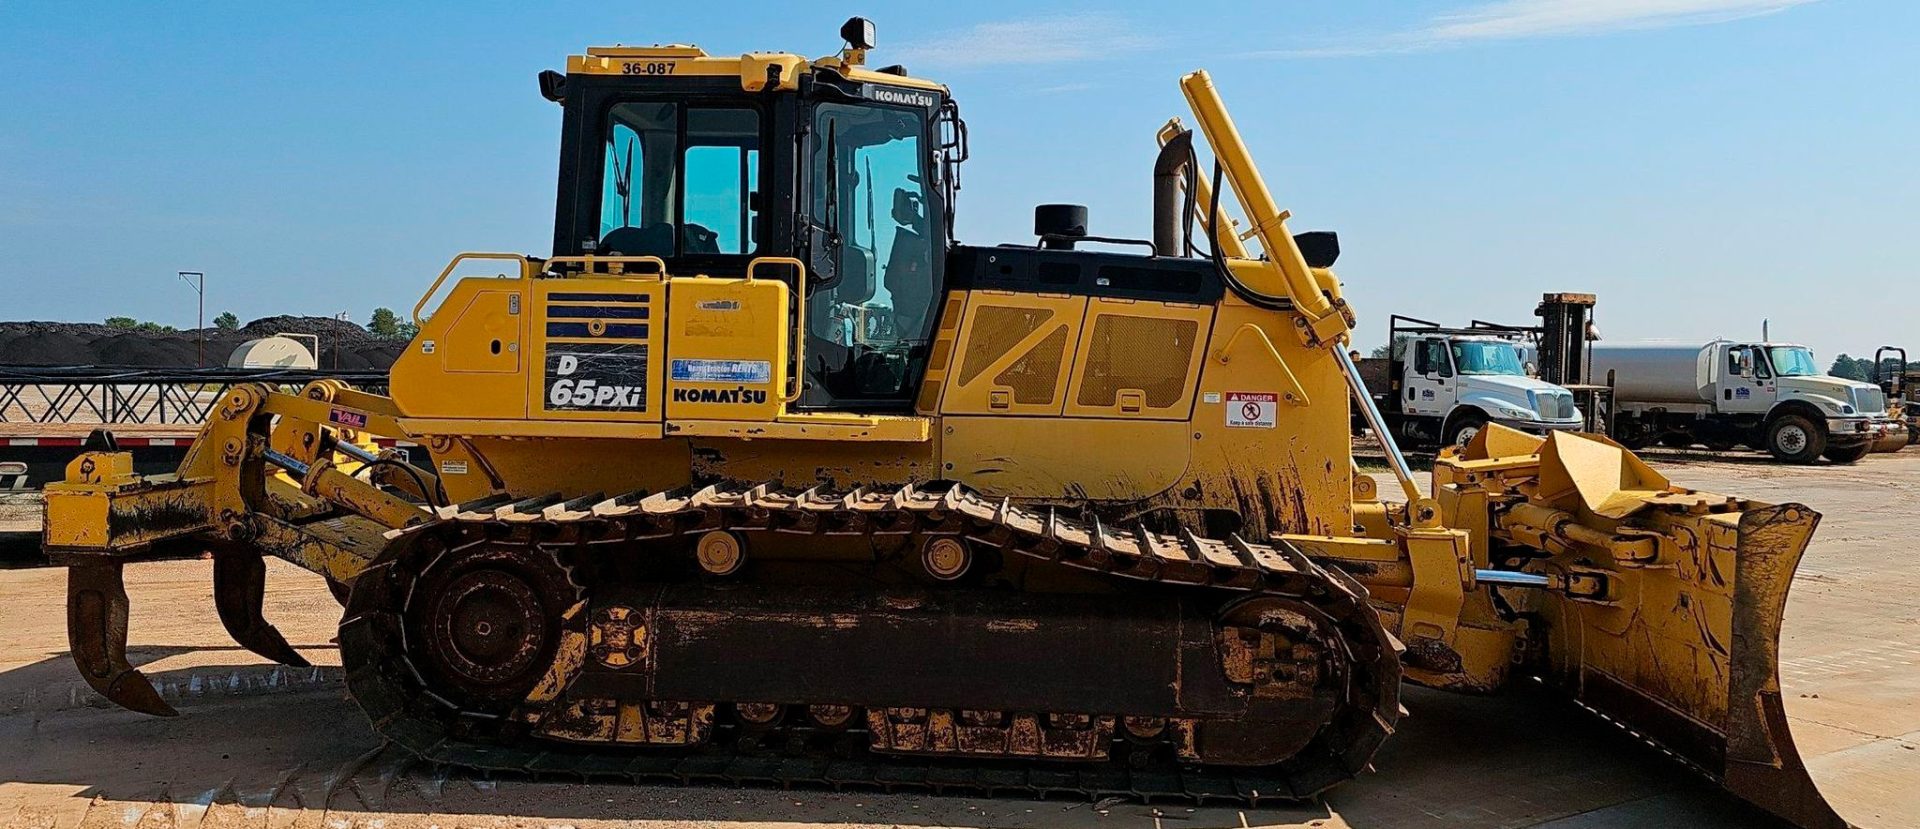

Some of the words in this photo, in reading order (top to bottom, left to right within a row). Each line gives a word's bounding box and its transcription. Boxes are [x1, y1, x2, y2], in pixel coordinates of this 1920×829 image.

[622, 62, 676, 75] 36-087
[875, 90, 933, 107] KOMATSU
[557, 355, 578, 375] D
[549, 379, 642, 407] 65PXi
[673, 386, 767, 404] KOMATSU
[1240, 394, 1273, 402] DANGER
